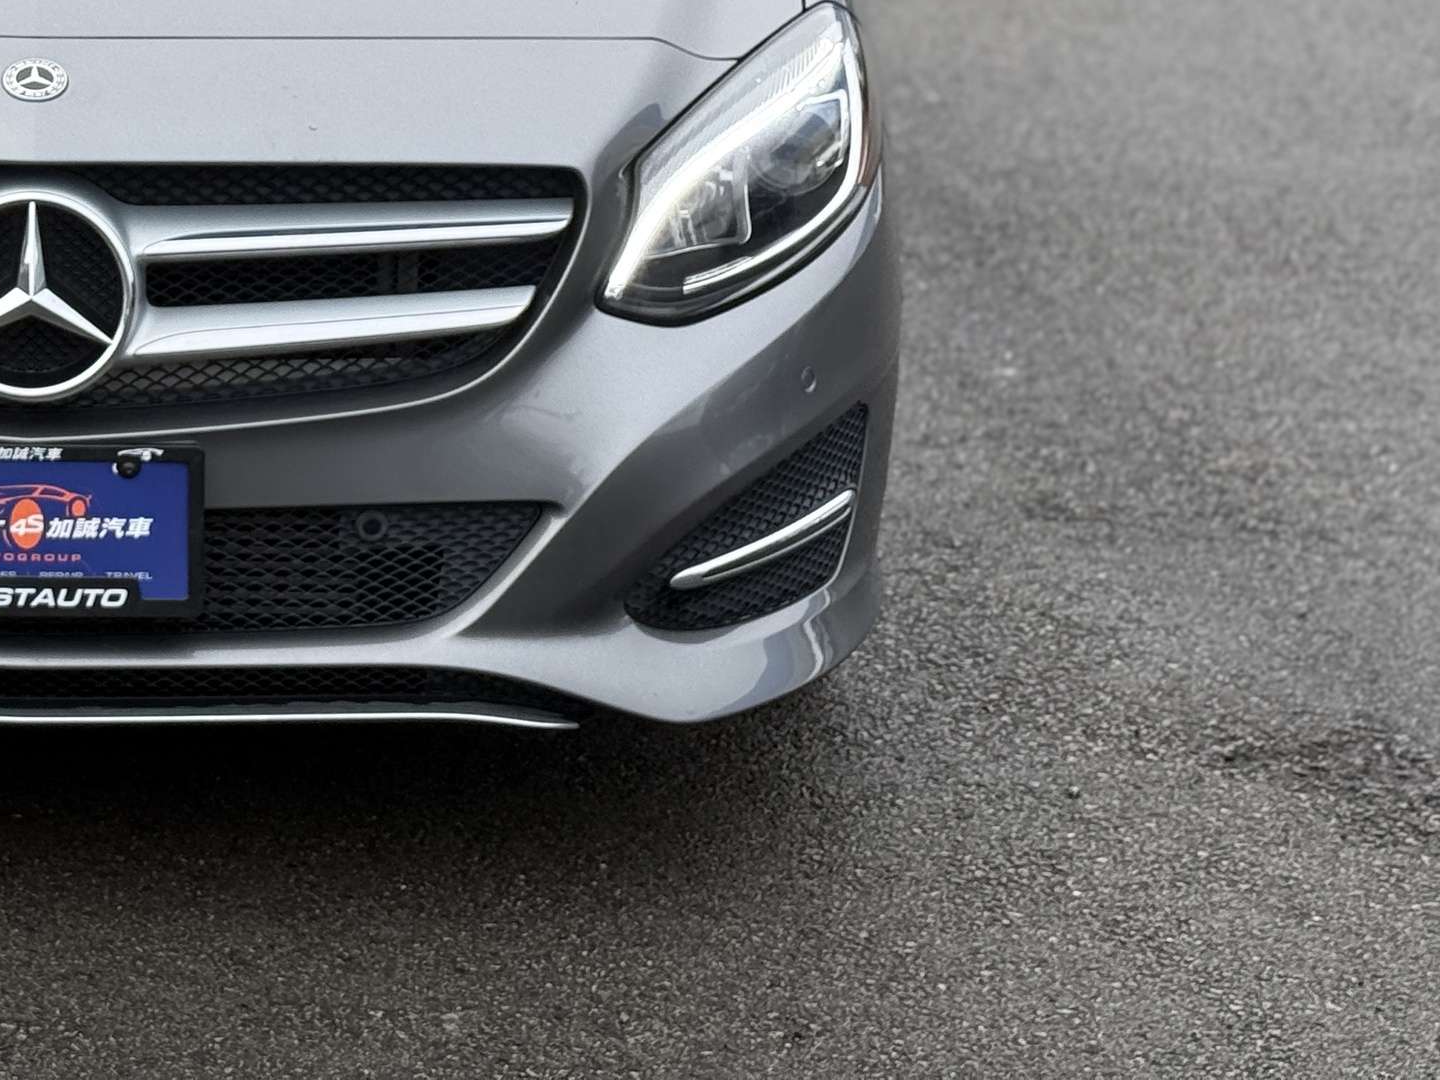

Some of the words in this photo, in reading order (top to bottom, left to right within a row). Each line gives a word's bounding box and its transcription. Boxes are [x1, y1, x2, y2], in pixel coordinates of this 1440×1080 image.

[9, 513, 44, 537] 4S
[46, 517, 154, 539] 加誠汽車
[105, 571, 153, 580] TRAVEL
